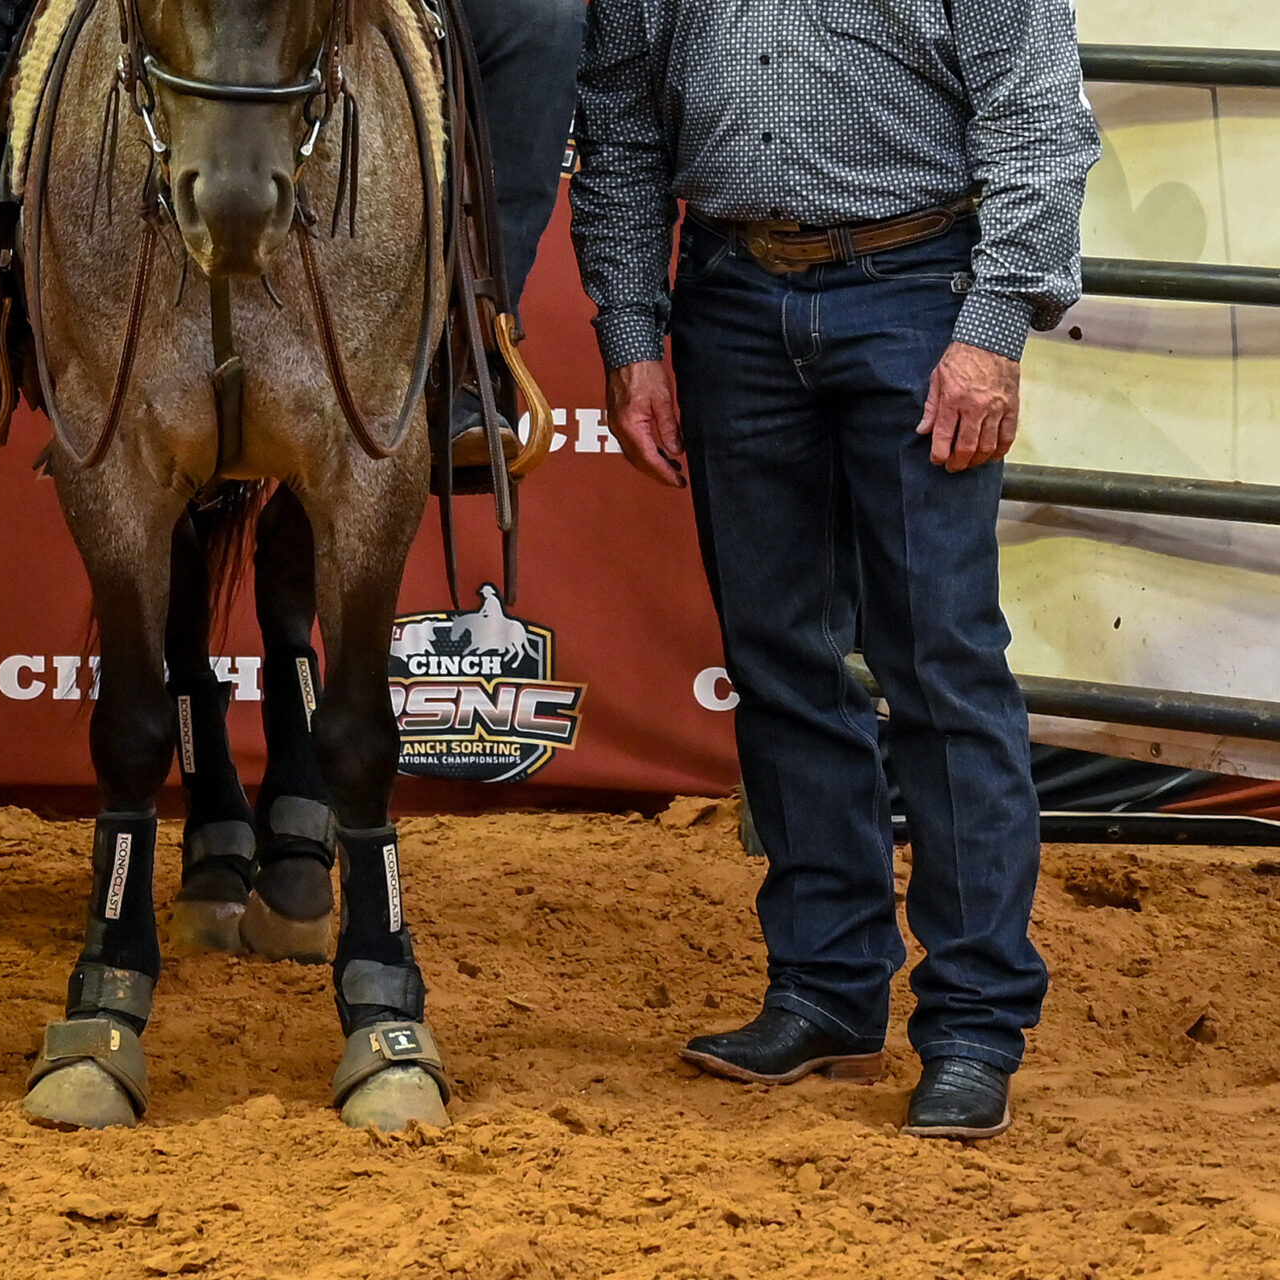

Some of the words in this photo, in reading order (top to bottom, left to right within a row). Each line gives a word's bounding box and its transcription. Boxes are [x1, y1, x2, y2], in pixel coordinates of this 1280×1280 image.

[408, 656, 502, 675] CINCH
[451, 742, 521, 756] SORTING
[442, 756, 521, 765] CHAMPIONSHIPS
[109, 836, 128, 915] ICONOCLAST
[386, 848, 399, 928] ICONOCLAST
